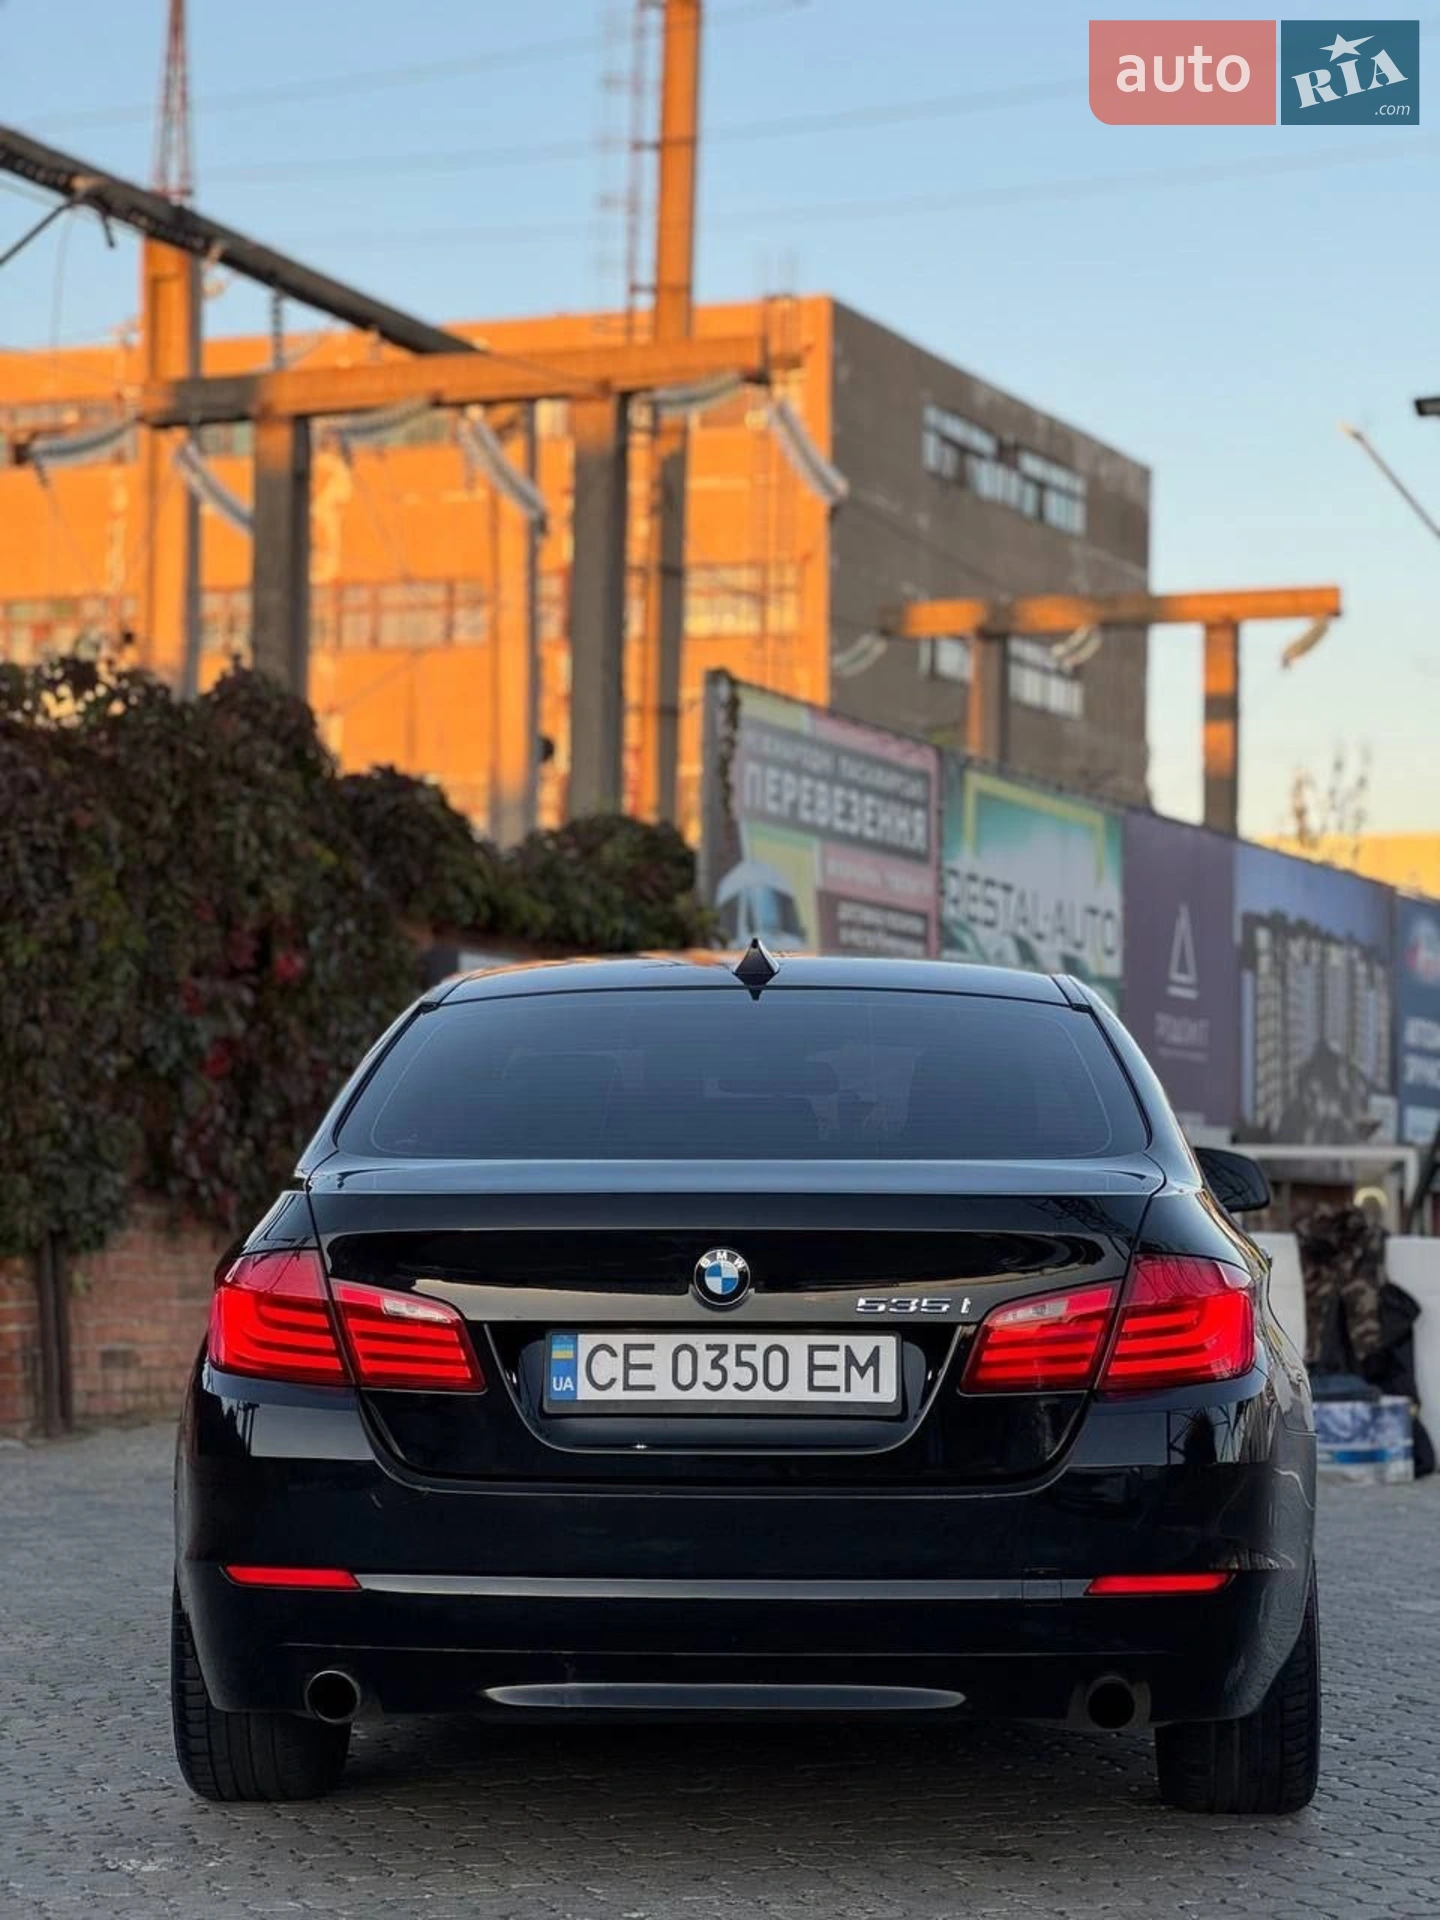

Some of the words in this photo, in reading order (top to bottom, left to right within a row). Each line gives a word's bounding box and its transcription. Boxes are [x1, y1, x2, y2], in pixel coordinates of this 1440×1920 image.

[743, 760, 929, 855] ПЕРЕВЕЗЕННЯ
[699, 1249, 746, 1271] BMW
[552, 1376, 575, 1391] UA
[584, 1343, 656, 1392] CE
[671, 1342, 790, 1392] 0350
[807, 1344, 881, 1393] EM
